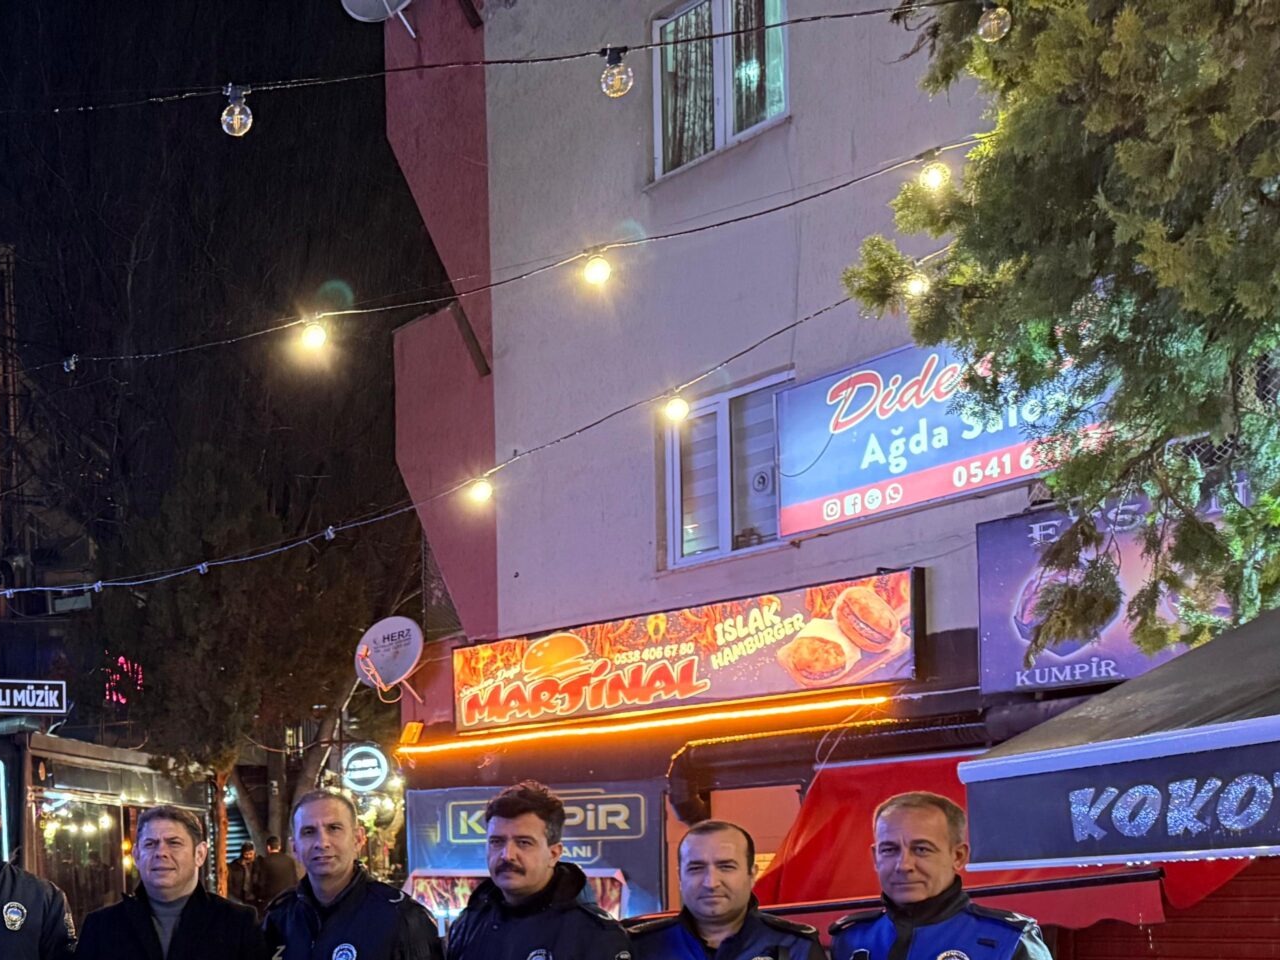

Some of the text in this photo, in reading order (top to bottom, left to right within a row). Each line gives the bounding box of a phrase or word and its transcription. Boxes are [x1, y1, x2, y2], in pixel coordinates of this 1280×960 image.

[827, 354, 966, 434] Dide
[860, 418, 949, 474] Ağda
[952, 452, 1012, 487] 0541
[382, 628, 412, 643] HERZ
[710, 614, 807, 670] HAMBURGER
[714, 602, 782, 646] ISLAK
[641, 645, 663, 660] 406
[663, 643, 678, 659] 67
[680, 642, 695, 655] 80
[13, 685, 60, 707] MÜZİK
[1069, 773, 1280, 843] KOKO
